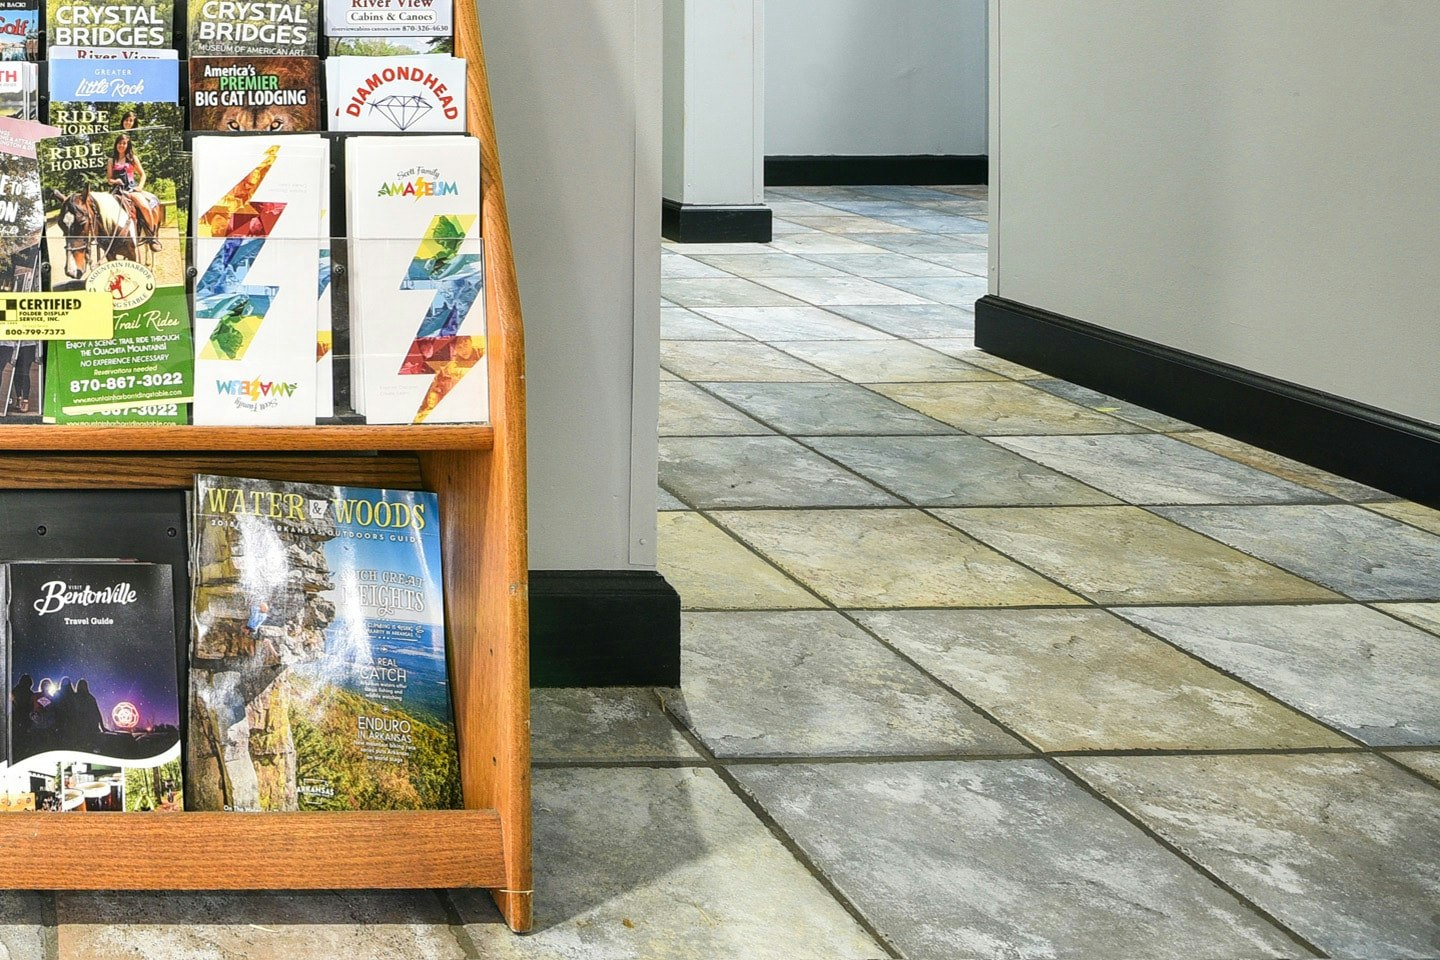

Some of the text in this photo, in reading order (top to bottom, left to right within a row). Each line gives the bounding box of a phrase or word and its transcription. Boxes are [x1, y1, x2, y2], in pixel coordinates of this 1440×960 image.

[55, 5, 164, 25] CRYSTAL
[202, 1, 308, 24] CRYSTAL
[350, 12, 434, 22] Cabins & Canoes
[55, 27, 165, 46] BRIDGES
[199, 22, 308, 45] BRIDGES
[199, 43, 234, 52] MUSEUM
[247, 46, 289, 55] AMERICAN
[290, 48, 305, 56] ART
[95, 68, 132, 76] GREATER
[203, 64, 256, 77] America's
[75, 79, 144, 98] Little Rock
[220, 76, 279, 90] PREMIER
[194, 90, 307, 107] BIG CAT LODGING
[345, 66, 459, 120] DIAMONDHEAD
[56, 110, 109, 124] RIDE
[50, 143, 104, 160] RIDE
[51, 157, 105, 172] HORSES
[397, 166, 441, 180] Scott Family
[11, 181, 23, 196] TO
[19, 298, 81, 310] CERTIFIED
[113, 310, 180, 332] Trail Rides
[93, 357, 131, 367] EXPERIENCE
[132, 354, 169, 363] NECESSARY
[70, 372, 183, 393] 870-867-3022
[208, 488, 426, 531] WATER & WOODS
[33, 580, 137, 616] Bentonville
[64, 617, 114, 625] Travel Guide
[360, 666, 407, 682] CATCH
[357, 716, 411, 733] ENDURO
[368, 730, 412, 744] ARKANSAS
